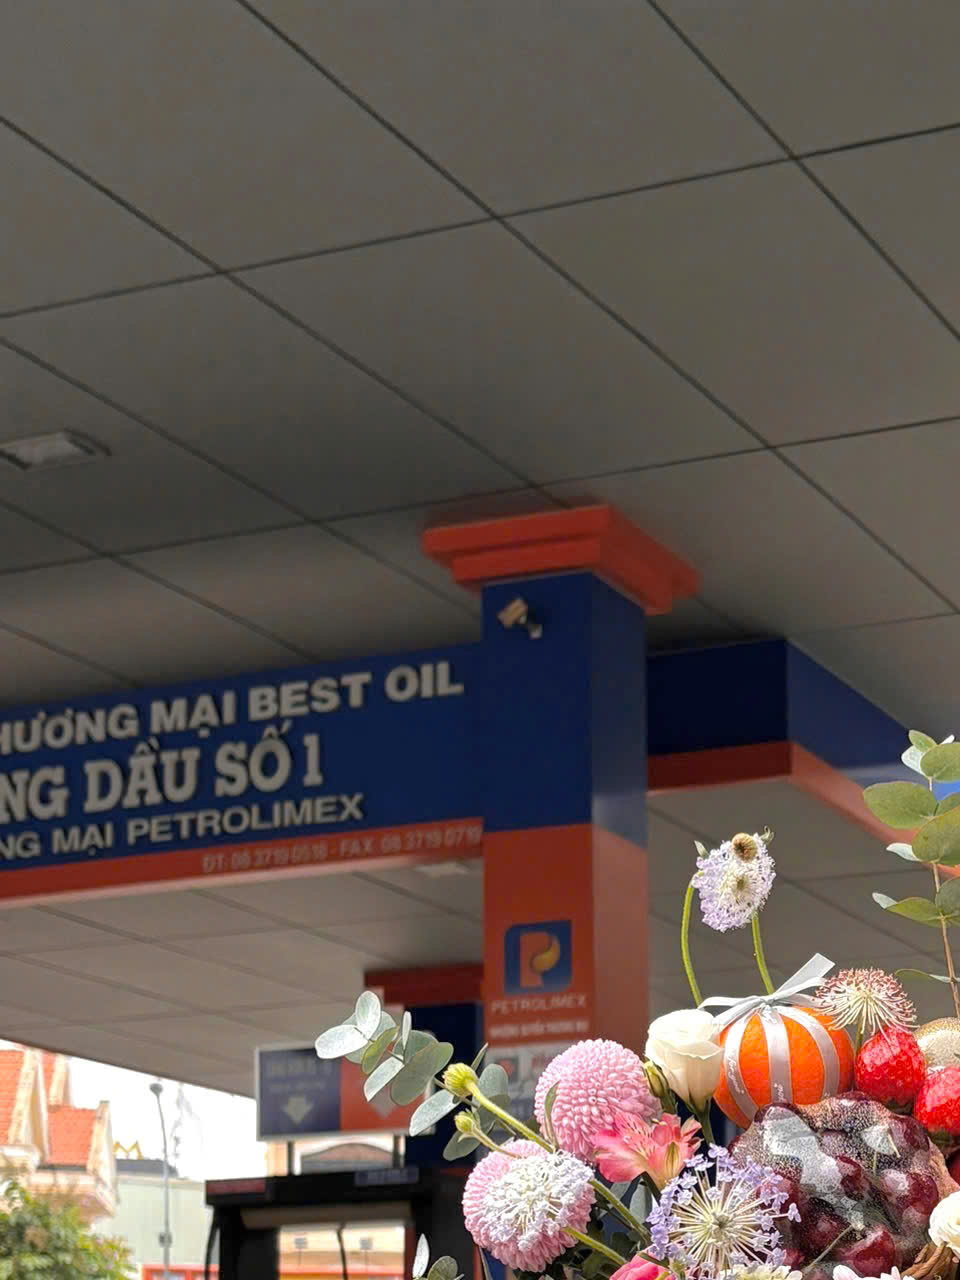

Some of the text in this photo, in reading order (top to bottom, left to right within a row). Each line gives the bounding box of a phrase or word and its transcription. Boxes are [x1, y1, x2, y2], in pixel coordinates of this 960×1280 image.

[151, 690, 236, 739] MẠI
[248, 672, 372, 722] BEST
[385, 661, 465, 702] OIL
[83, 735, 201, 814] DẦU
[215, 719, 292, 797] SỐ
[303, 733, 324, 787] 1
[52, 822, 114, 856] MẠI
[127, 792, 365, 846] PETROLIMEX
